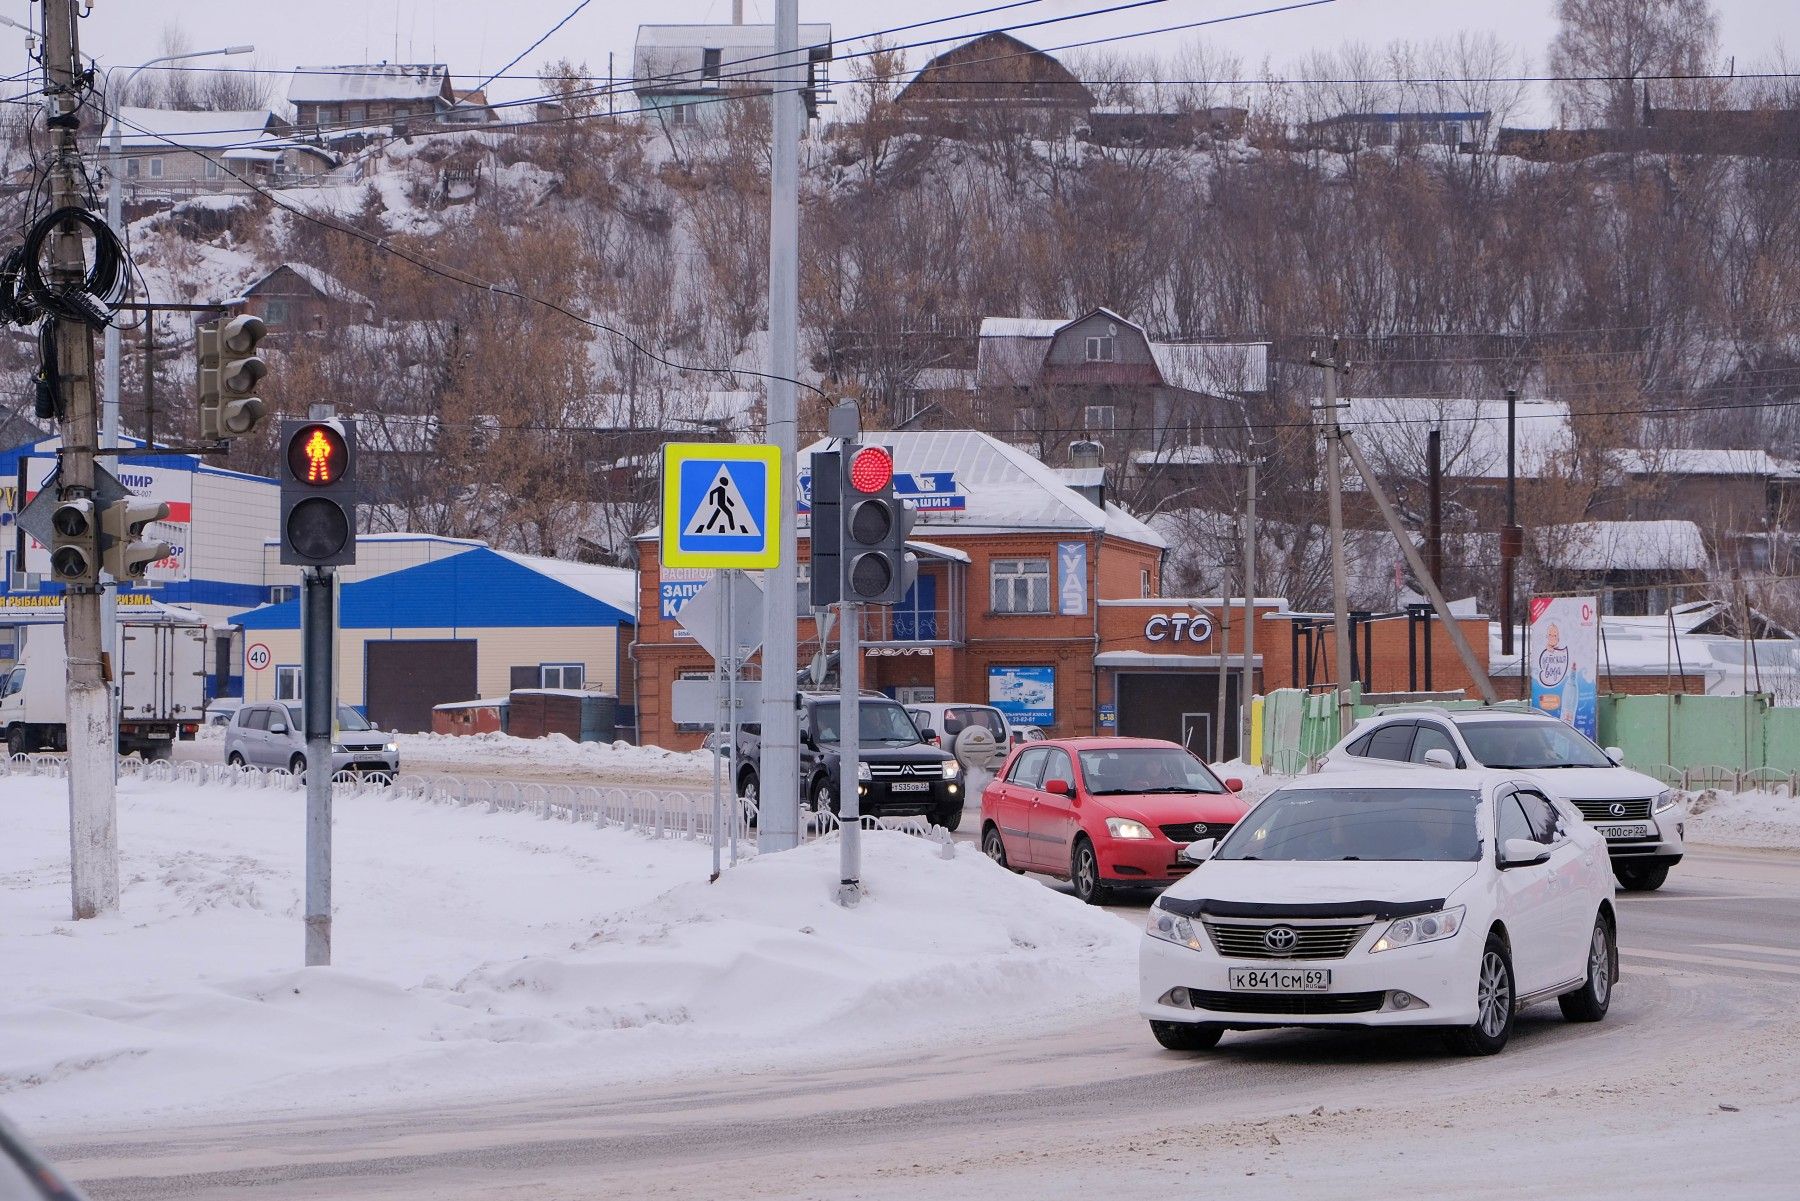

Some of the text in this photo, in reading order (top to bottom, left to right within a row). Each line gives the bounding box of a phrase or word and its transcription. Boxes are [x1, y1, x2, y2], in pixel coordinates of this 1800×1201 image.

[1062, 554, 1084, 615] УАЗ
[9, 595, 61, 607] РЫБАЛКИ
[1144, 615, 1213, 643] СТО
[250, 651, 267, 664] 40
[1305, 971, 1322, 984] 69
